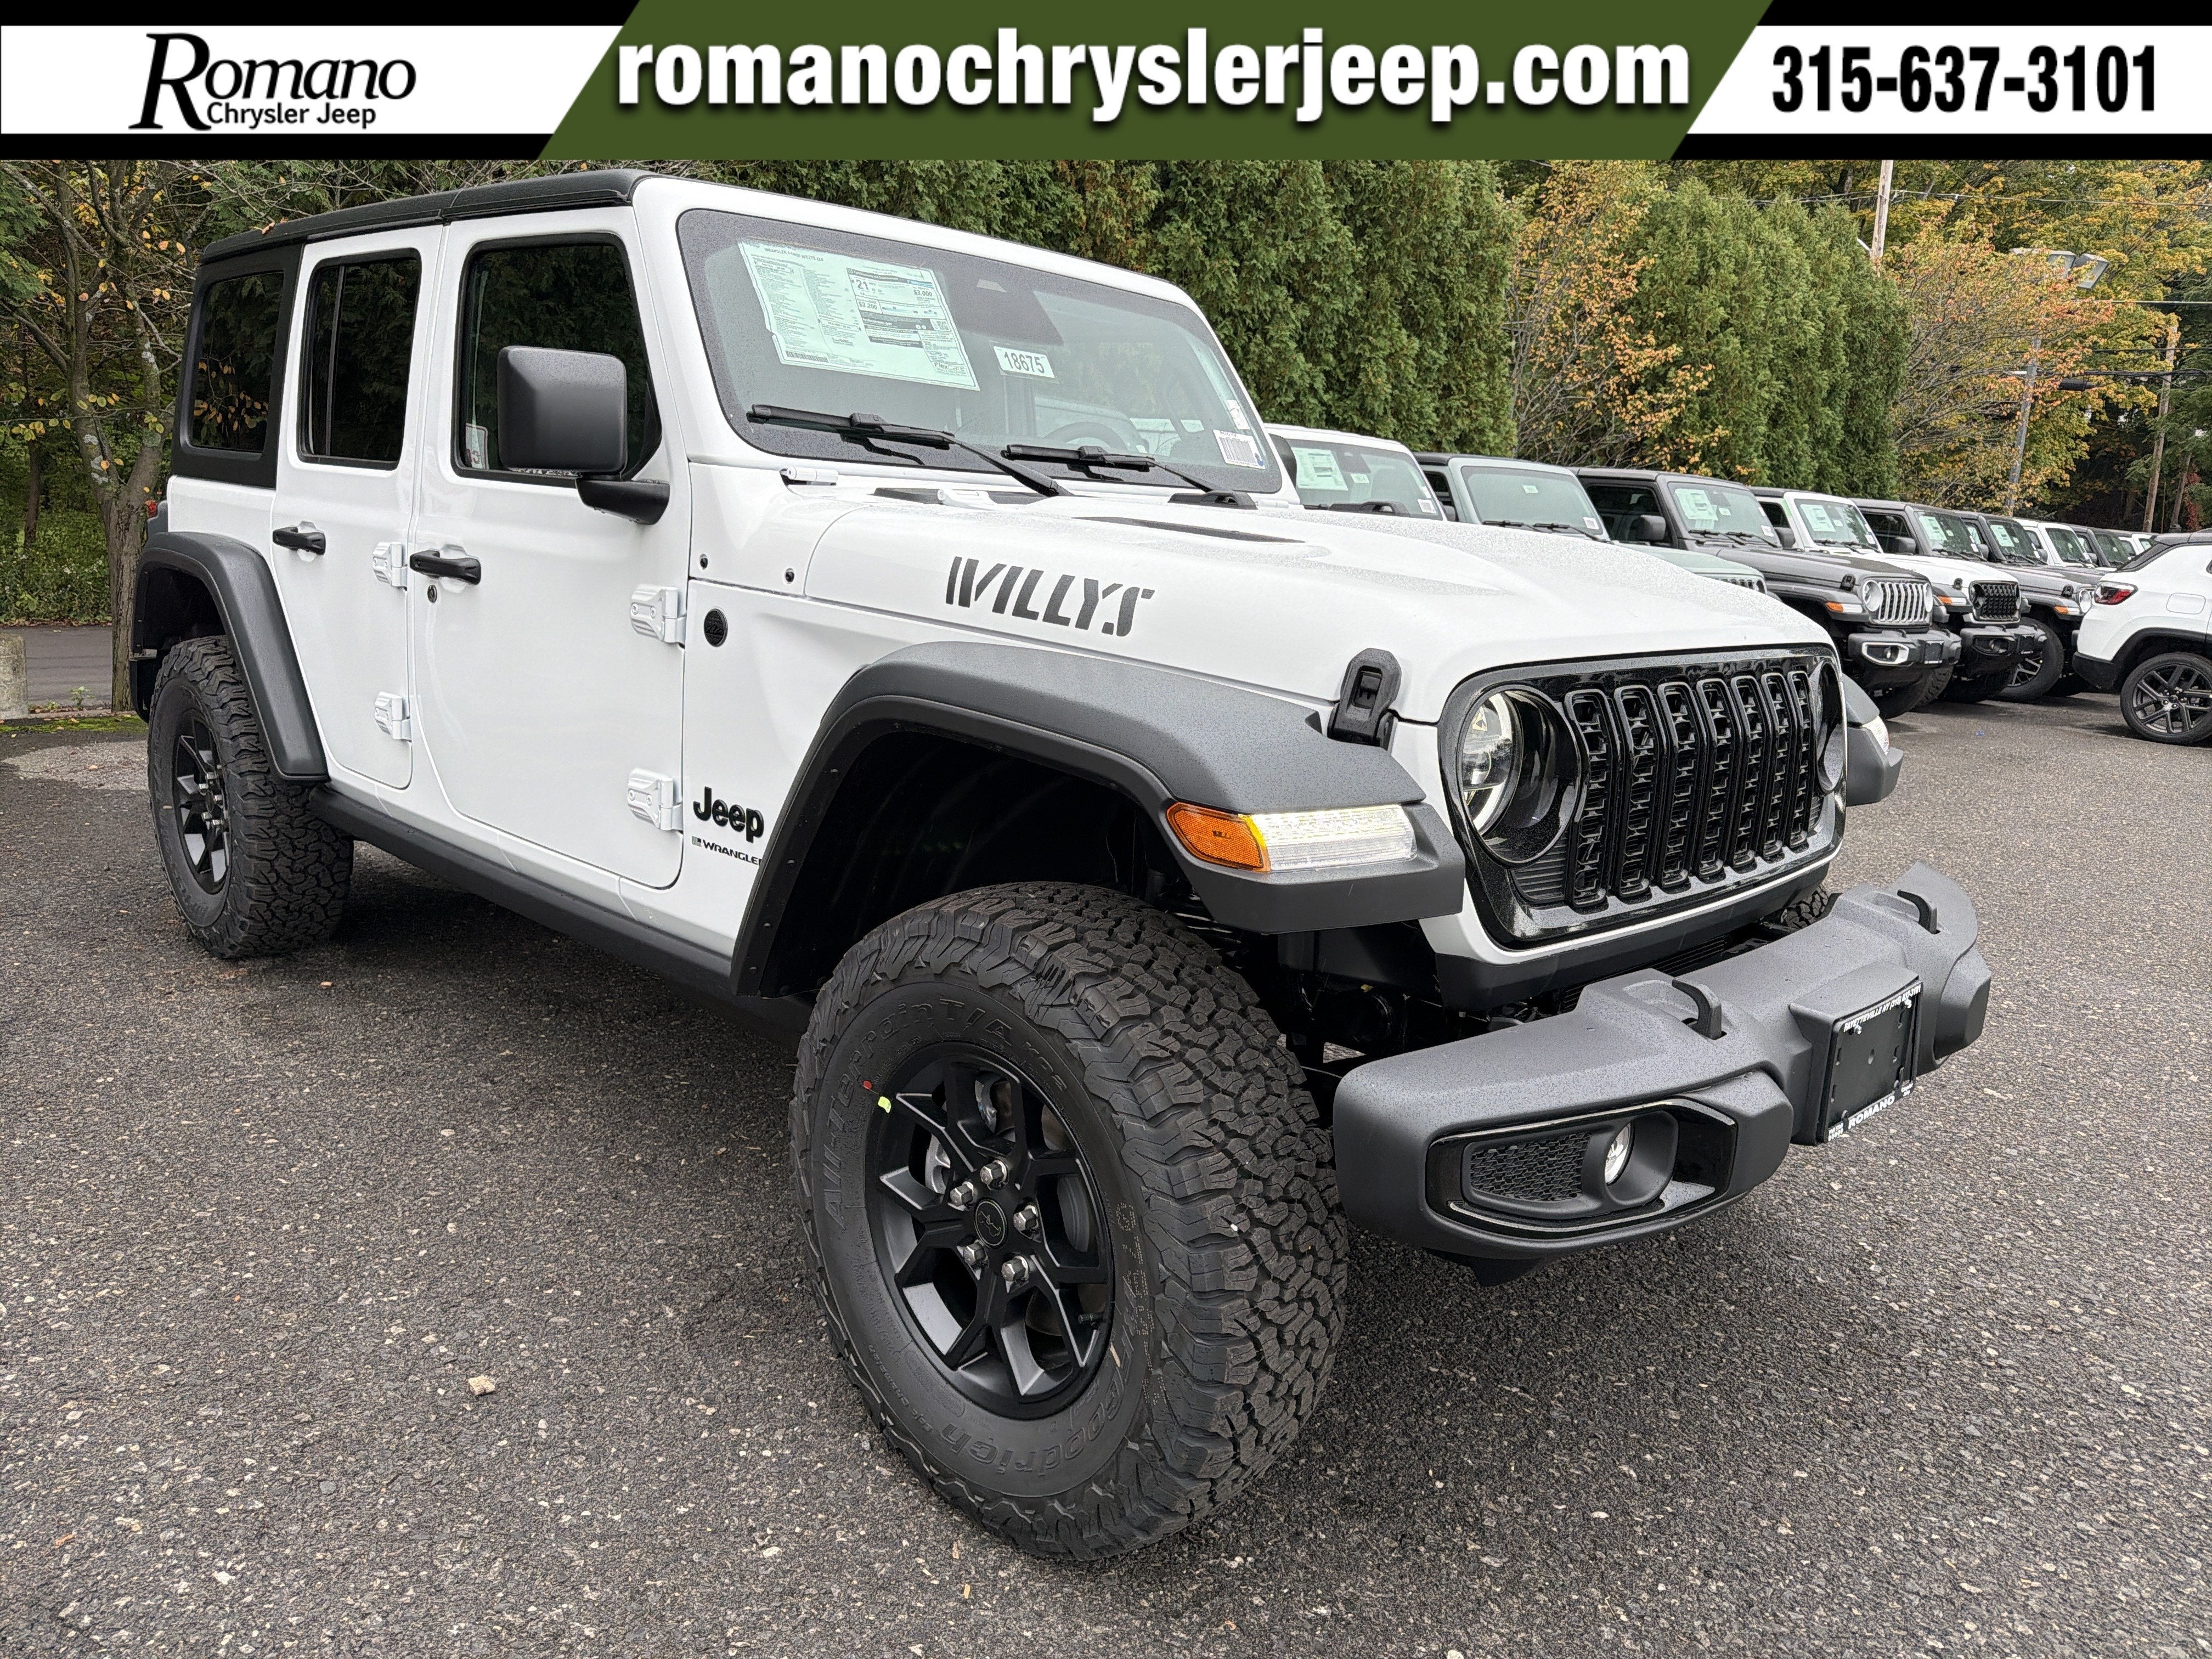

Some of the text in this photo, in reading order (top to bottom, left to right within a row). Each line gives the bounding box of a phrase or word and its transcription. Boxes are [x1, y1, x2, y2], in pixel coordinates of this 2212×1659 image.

[856, 279, 868, 291] 21
[1005, 352, 1045, 374] 18675
[945, 556, 1155, 637] WILLYS
[693, 786, 764, 843] Jeep
[821, 998, 938, 1229] All-Terrain
[1848, 1096, 1895, 1130] ROMANO
